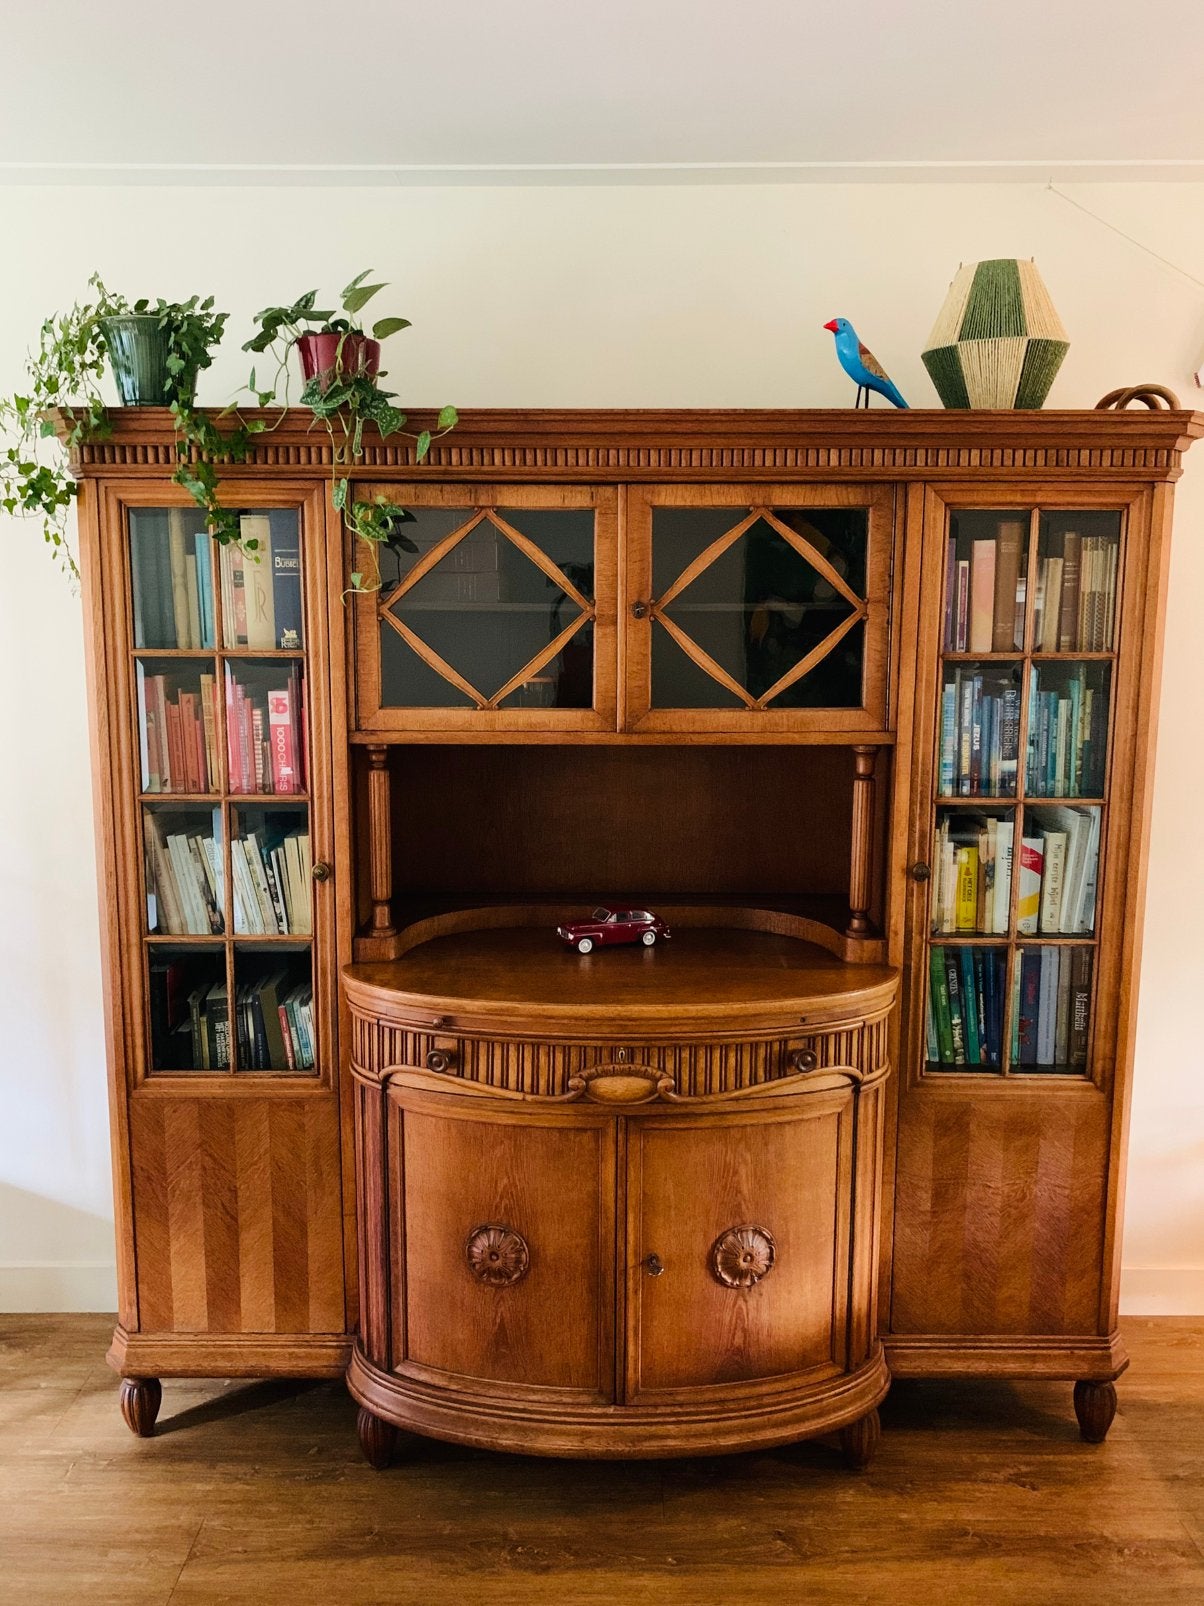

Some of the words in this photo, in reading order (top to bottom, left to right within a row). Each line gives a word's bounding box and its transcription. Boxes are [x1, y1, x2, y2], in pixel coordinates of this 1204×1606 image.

[276, 726, 285, 752] 1000
[973, 723, 981, 751] JEZUS
[277, 753, 287, 791] CHRS
[1051, 862, 1059, 883] eerste
